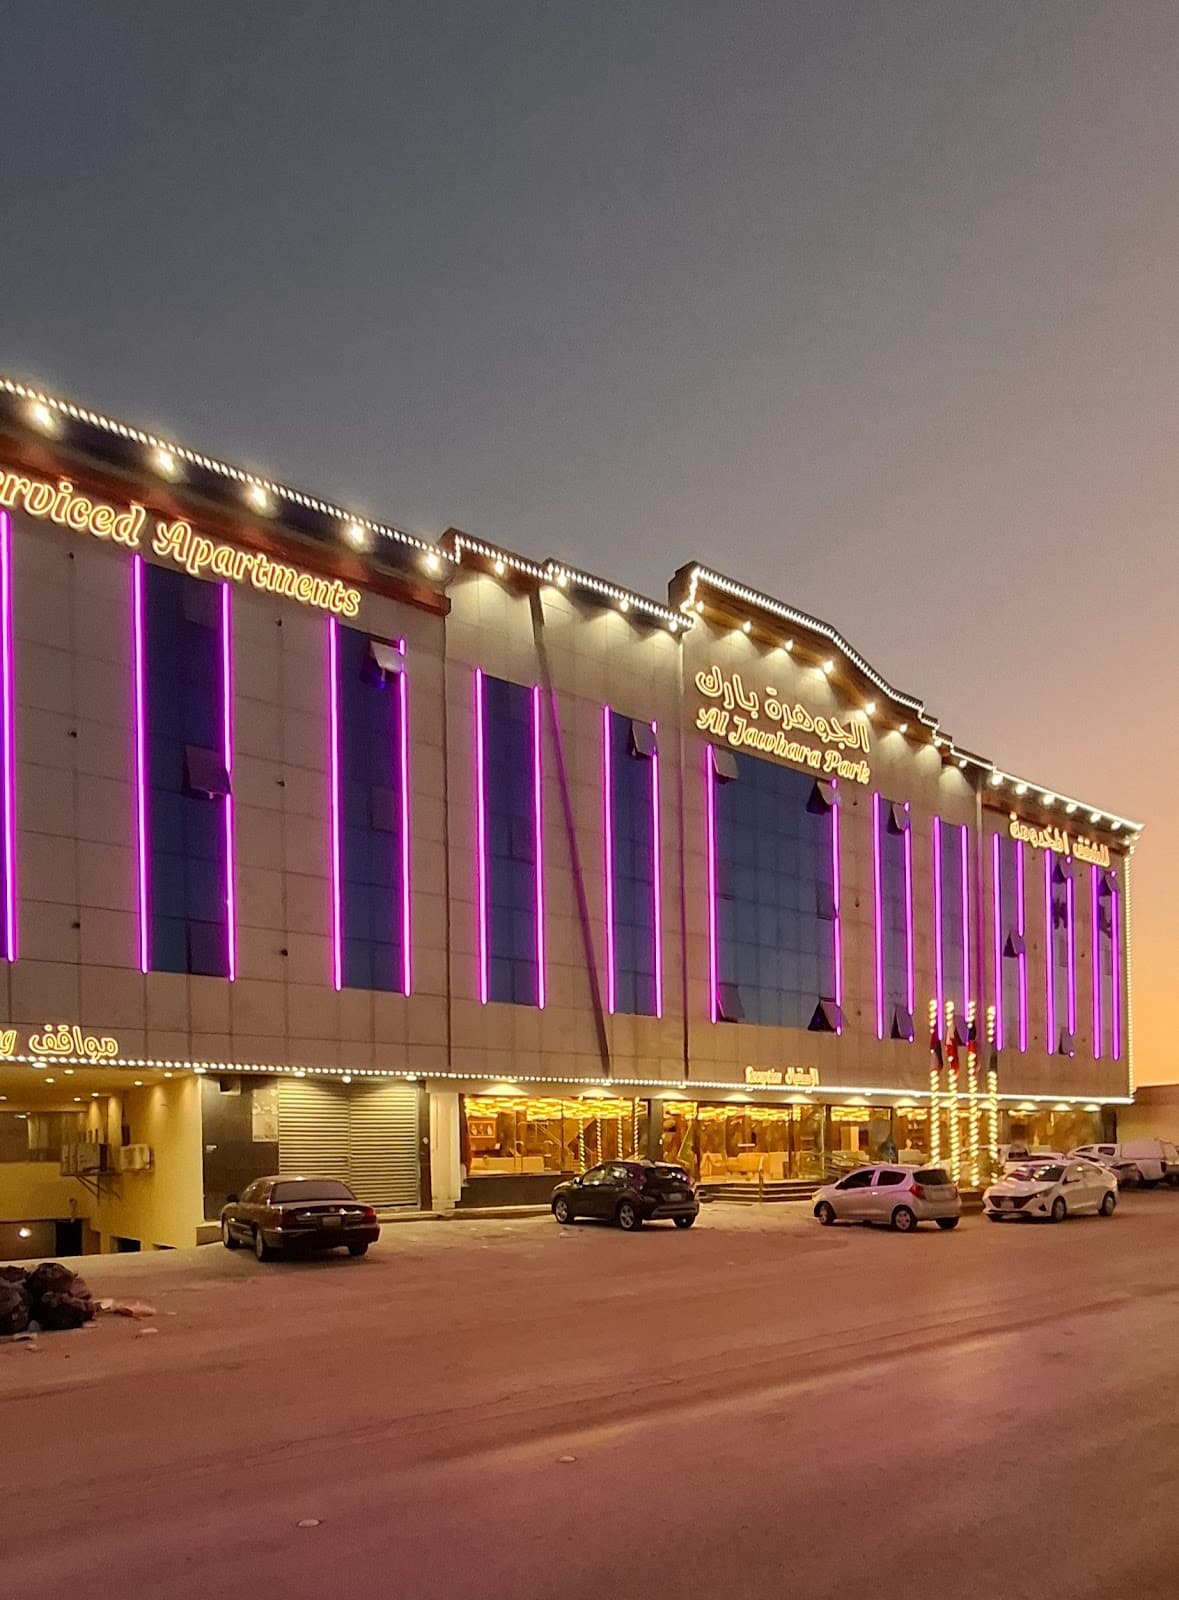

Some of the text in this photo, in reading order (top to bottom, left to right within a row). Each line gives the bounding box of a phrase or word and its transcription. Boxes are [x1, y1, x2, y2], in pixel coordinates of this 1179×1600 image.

[0, 471, 362, 617] rviced Apartments
[694, 665, 870, 753] الجوهرة بارك
[696, 707, 872, 785] Al Jawhara Park
[28, 1023, 119, 1060] مواقف
